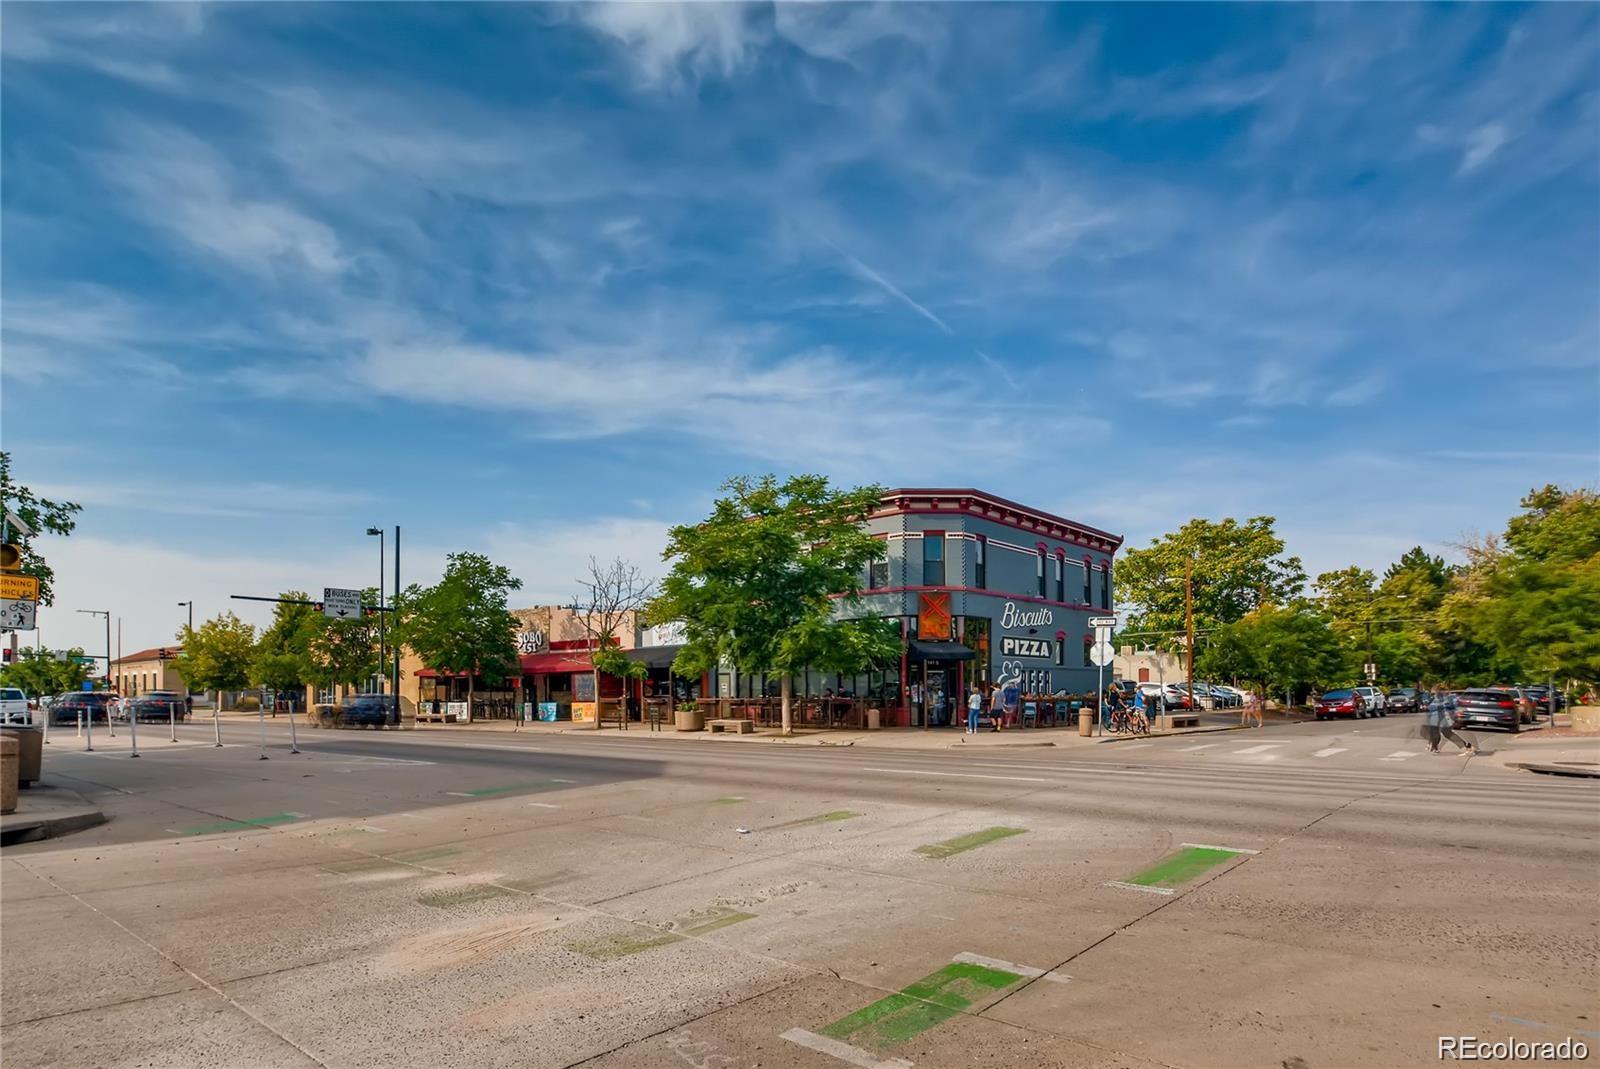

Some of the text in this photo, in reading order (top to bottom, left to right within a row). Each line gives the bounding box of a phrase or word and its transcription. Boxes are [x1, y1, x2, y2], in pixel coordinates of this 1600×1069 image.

[1000, 602, 1053, 629] Biscuits
[517, 631, 542, 649] SOBO
[1003, 638, 1050, 657] PIZZA
